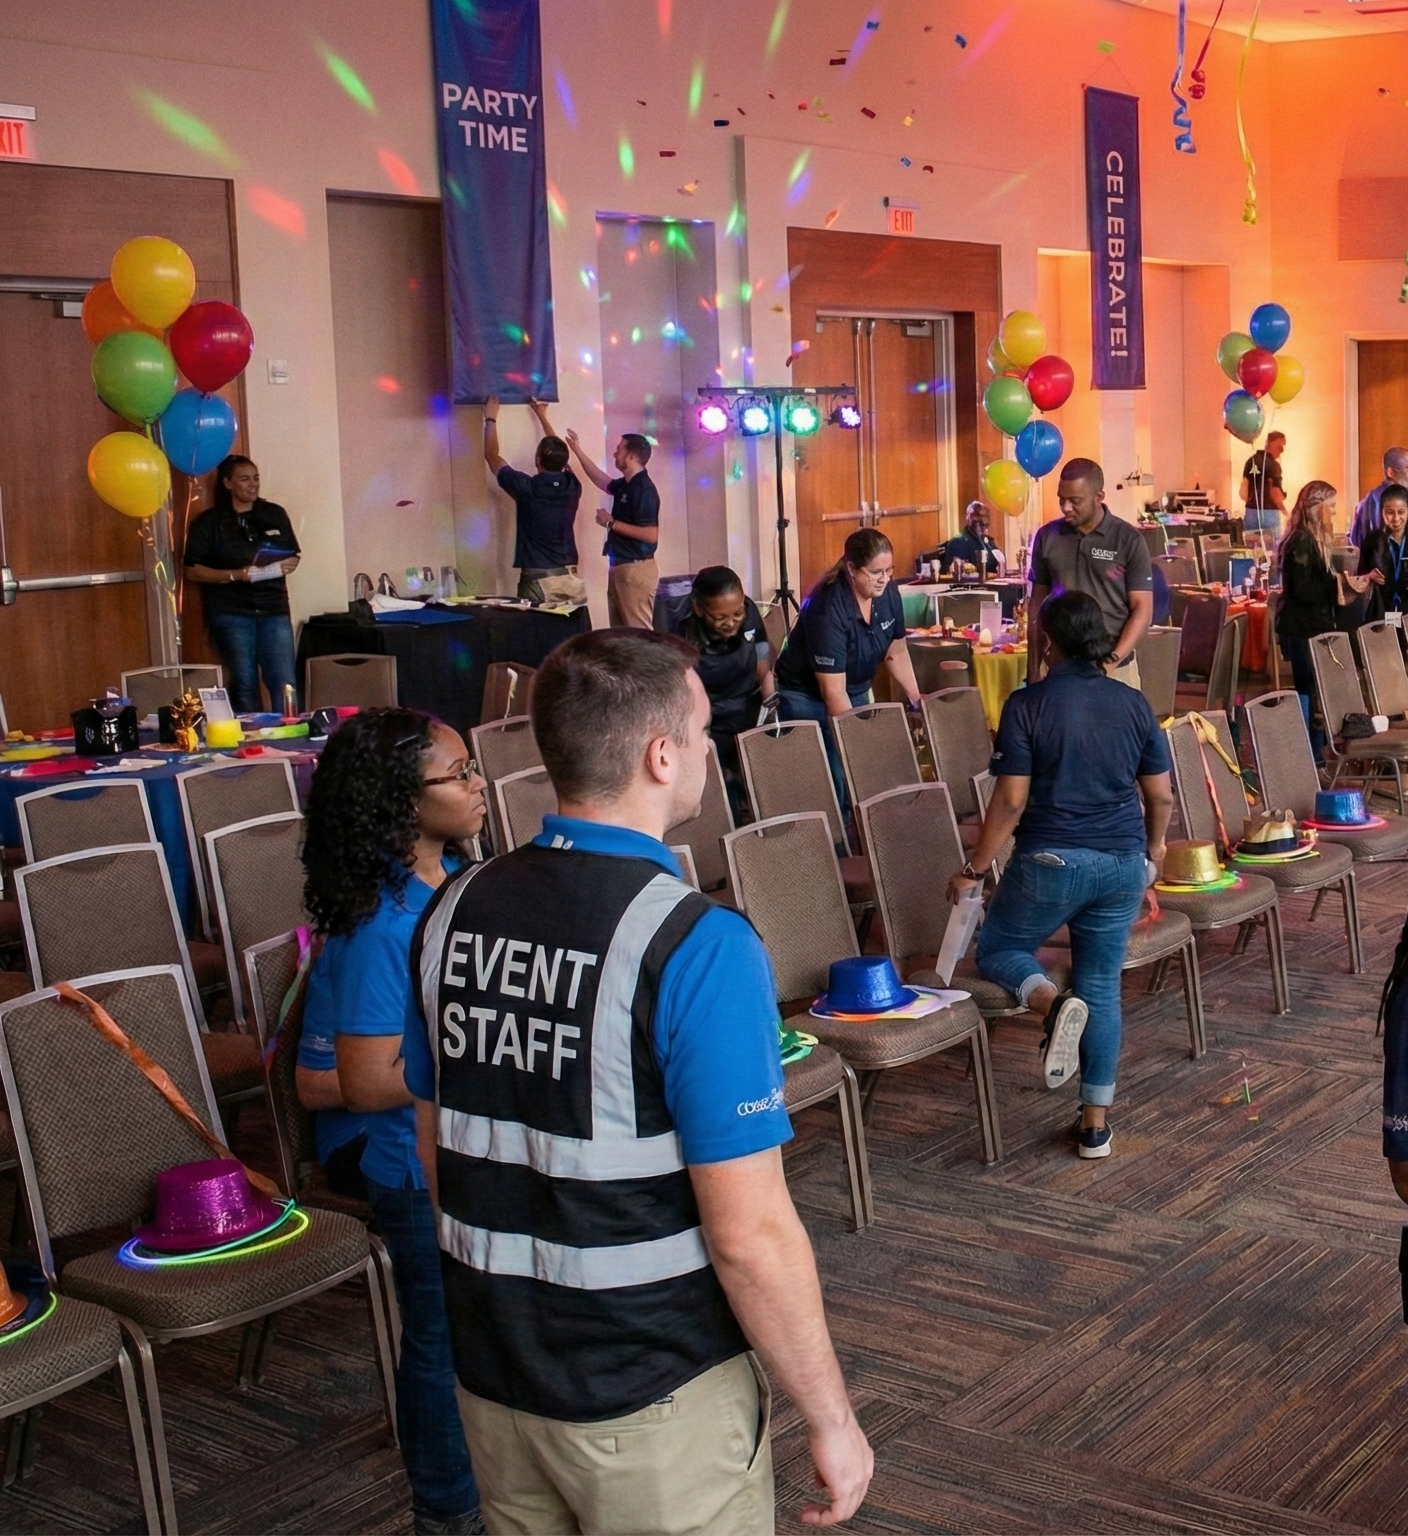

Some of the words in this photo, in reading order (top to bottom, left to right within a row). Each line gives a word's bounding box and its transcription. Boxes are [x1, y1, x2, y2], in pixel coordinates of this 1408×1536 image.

[442, 82, 538, 120] PARTY
[0, 120, 24, 155] XIT
[458, 119, 528, 153] TIME
[1106, 150, 1129, 357] CELEBRATE!
[443, 930, 599, 1010] EVENT
[442, 1001, 581, 1081] STAFF
